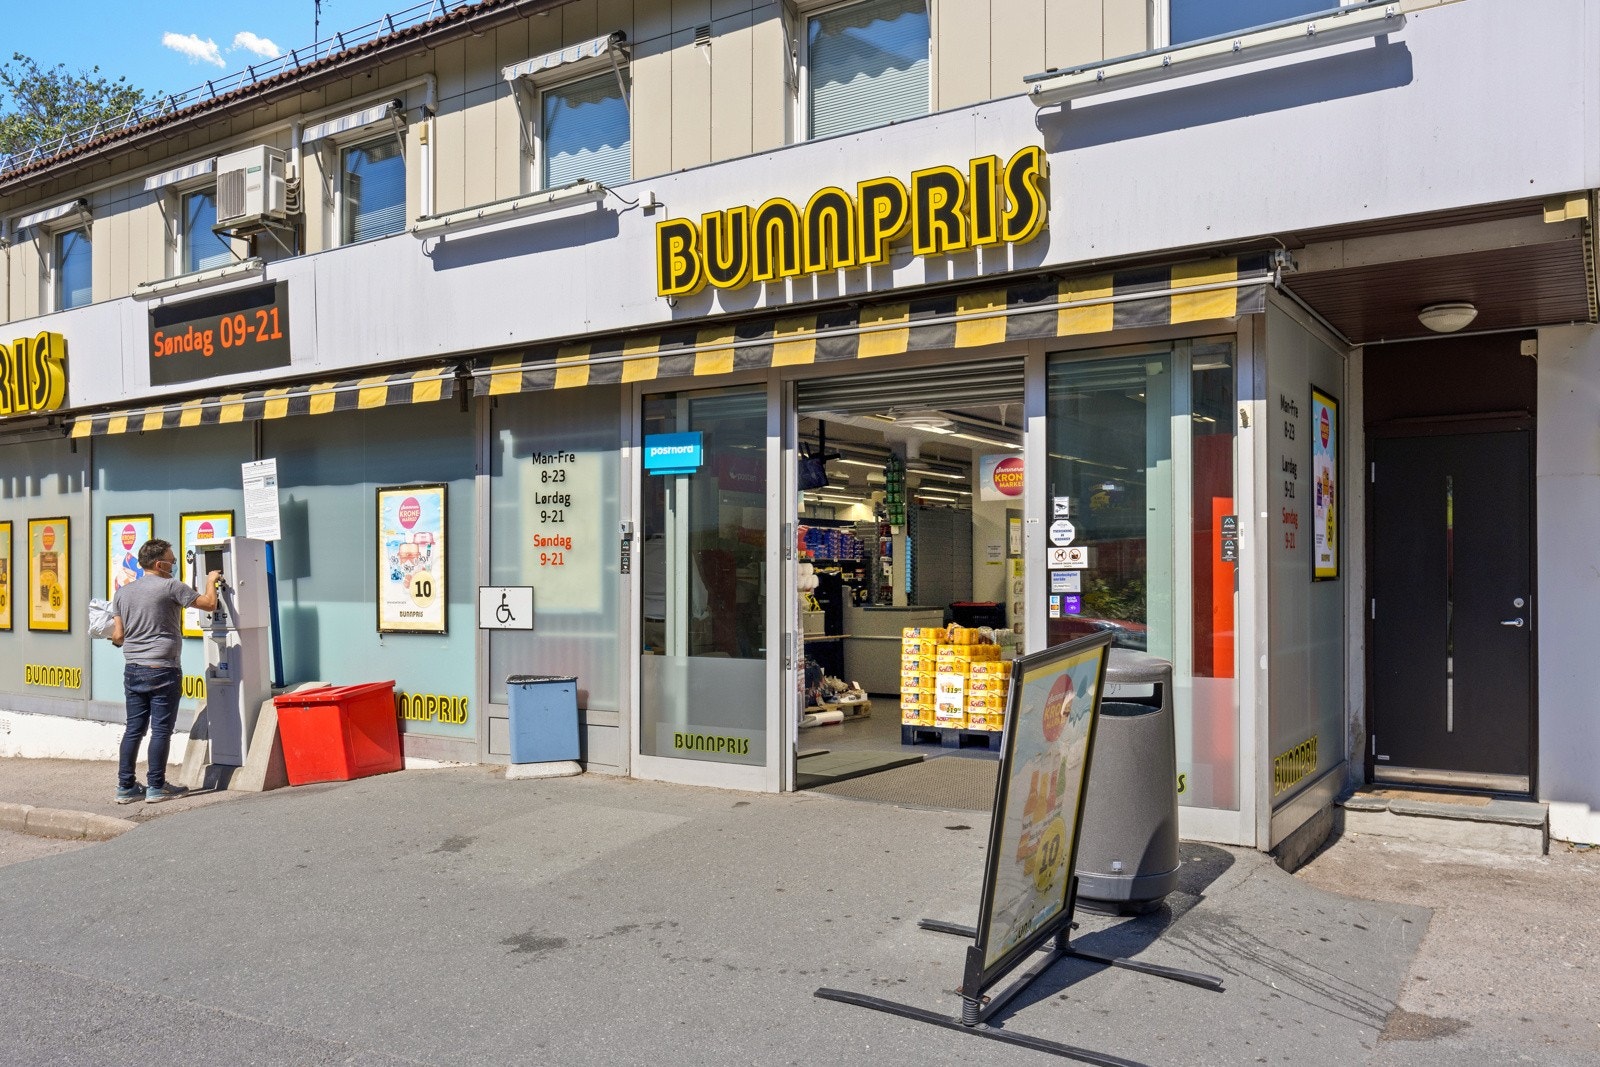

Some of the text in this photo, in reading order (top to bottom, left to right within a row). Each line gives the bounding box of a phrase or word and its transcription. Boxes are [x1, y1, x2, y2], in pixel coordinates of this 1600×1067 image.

[656, 145, 1047, 297] BUNNPRIS
[153, 307, 282, 357] Søndag 09-21
[532, 450, 575, 465] Man-Fre
[541, 469, 566, 483] 8-23
[535, 490, 571, 507] Lørdag
[540, 509, 564, 523] 9-21
[533, 534, 572, 550] Søndag
[540, 552, 564, 566] 9-21
[415, 580, 432, 598] 10
[25, 664, 81, 689] BUNNPRIS
[182, 675, 207, 699] UN
[396, 692, 468, 724] NNPRIS
[674, 731, 750, 755] BUNNPRIS
[1274, 735, 1317, 797] BUNNPRIS
[1039, 833, 1060, 875] 10
